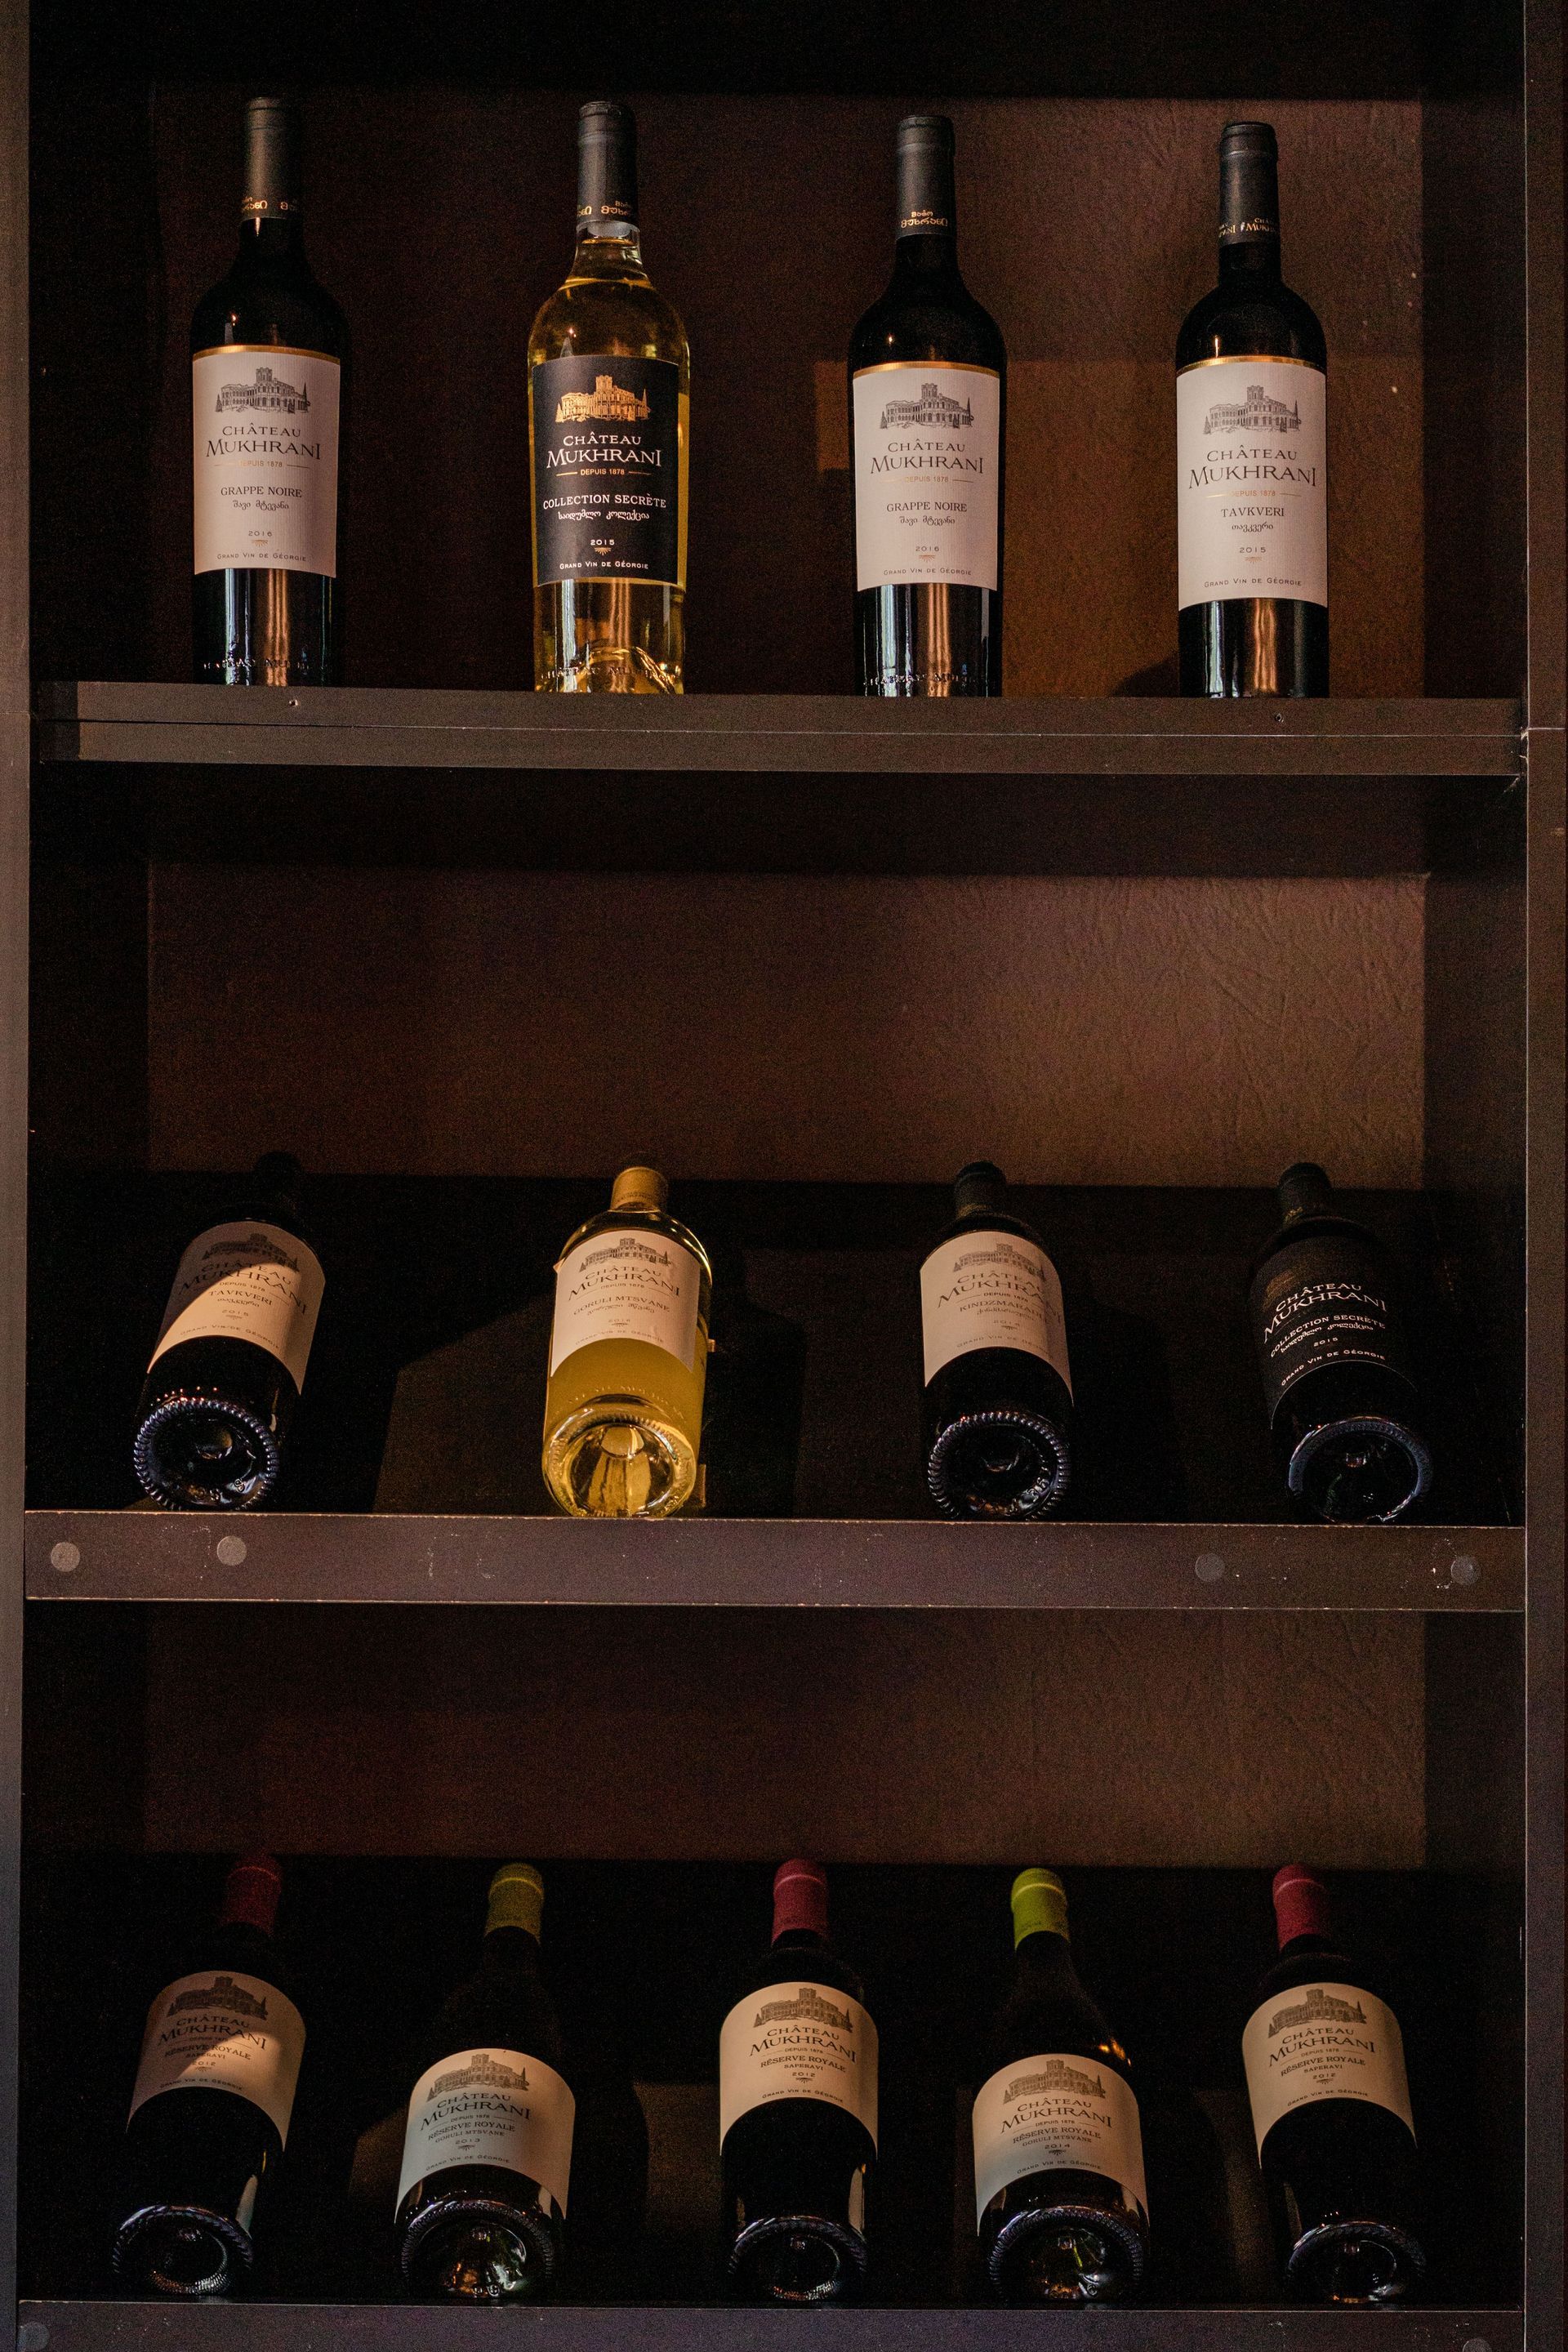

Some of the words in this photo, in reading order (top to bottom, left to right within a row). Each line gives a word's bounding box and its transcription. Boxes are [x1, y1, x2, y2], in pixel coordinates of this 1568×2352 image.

[222, 423, 301, 437] CHÂTEAU
[564, 431, 641, 446] CHÂTEAU
[888, 439, 965, 452] CHÂTEAU
[207, 439, 321, 460] MUKHRANI
[1207, 445, 1297, 462] CHÂTEAU
[546, 448, 661, 469] MUKHRANI
[871, 456, 983, 474] MUKHRANI
[1189, 466, 1316, 489] MUKHRANI
[220, 486, 264, 497] GRAPPE
[268, 487, 301, 497] NOIRE
[543, 493, 609, 510] COLLECTION
[614, 493, 666, 508] SECRÈTE
[887, 502, 930, 512] GRAPPE
[934, 502, 967, 512] NOIRE
[1221, 507, 1285, 517] TAVKVERI
[586, 1266, 662, 1280] CHÂTEAU
[179, 1269, 306, 1314] MUKHRANI
[568, 1273, 679, 1302] MUKHRANI
[209, 1290, 272, 1306] TAVKVERI
[616, 1296, 670, 1312] MTSVANE
[1276, 1283, 1361, 1312] CHÂTEAU
[1264, 1291, 1387, 1343] MUKHRANI
[1271, 1316, 1330, 1357] COLLECTION
[1334, 1315, 1386, 1329] SECRÈTE
[1313, 1337, 1338, 1347] 2015
[176, 2014, 249, 2028] CHÂTEAU
[158, 2025, 266, 2050] MUKHRANI
[768, 2025, 839, 2040] CHÂTEAU
[1282, 2028, 1354, 2044] CHÂTEAU
[212, 2046, 251, 2060] ROYALE
[750, 2036, 856, 2063] MUKHRANI
[1269, 2037, 1375, 2067] MUKHRANI
[808, 2056, 846, 2073] ROYALE
[1281, 2058, 1323, 2077] RÉSERVE
[1327, 2056, 1365, 2065] ROYALE
[1304, 2065, 1342, 2074] SAPERAVI
[437, 2093, 510, 2108] CHÂTEAU
[1018, 2097, 1091, 2112] CHÂTEAU
[421, 2101, 530, 2131] MUKHRANI
[1001, 2108, 1112, 2134] MUKHRANI
[428, 2122, 470, 2140] RÉSERVE
[474, 2121, 515, 2132] ROYALE
[435, 2131, 462, 2143] GORULI
[1062, 2127, 1101, 2139] ROYALE
[1022, 2136, 1050, 2147] GORULI
[1054, 2135, 1092, 2143] MTSVANE
